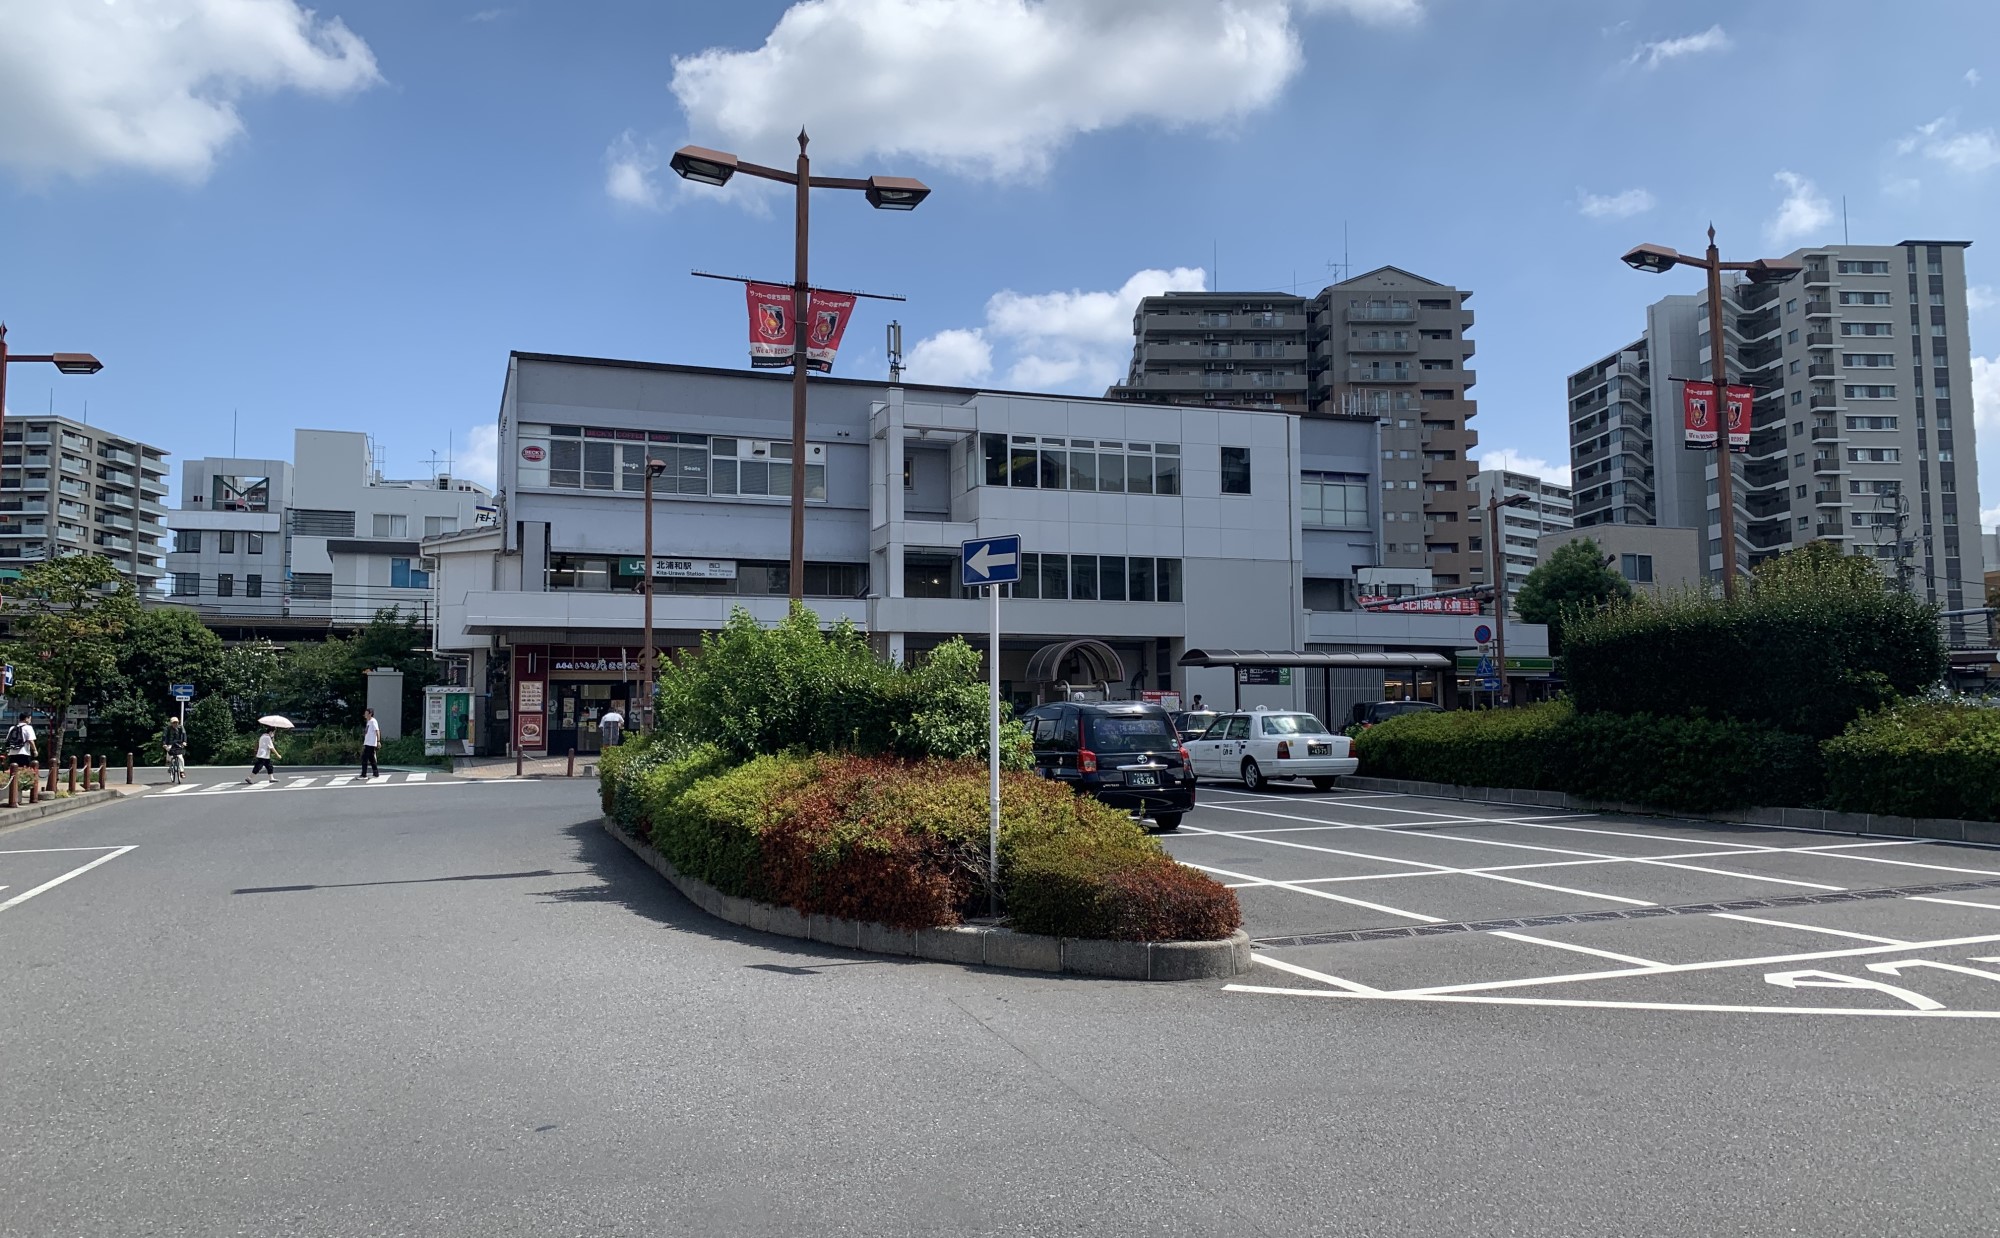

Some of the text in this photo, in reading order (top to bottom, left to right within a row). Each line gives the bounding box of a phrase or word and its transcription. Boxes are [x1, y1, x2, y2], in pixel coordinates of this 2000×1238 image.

[616, 431, 644, 440] COFFEE
[629, 560, 646, 571] JR
[656, 560, 692, 570] 北浦和駅
